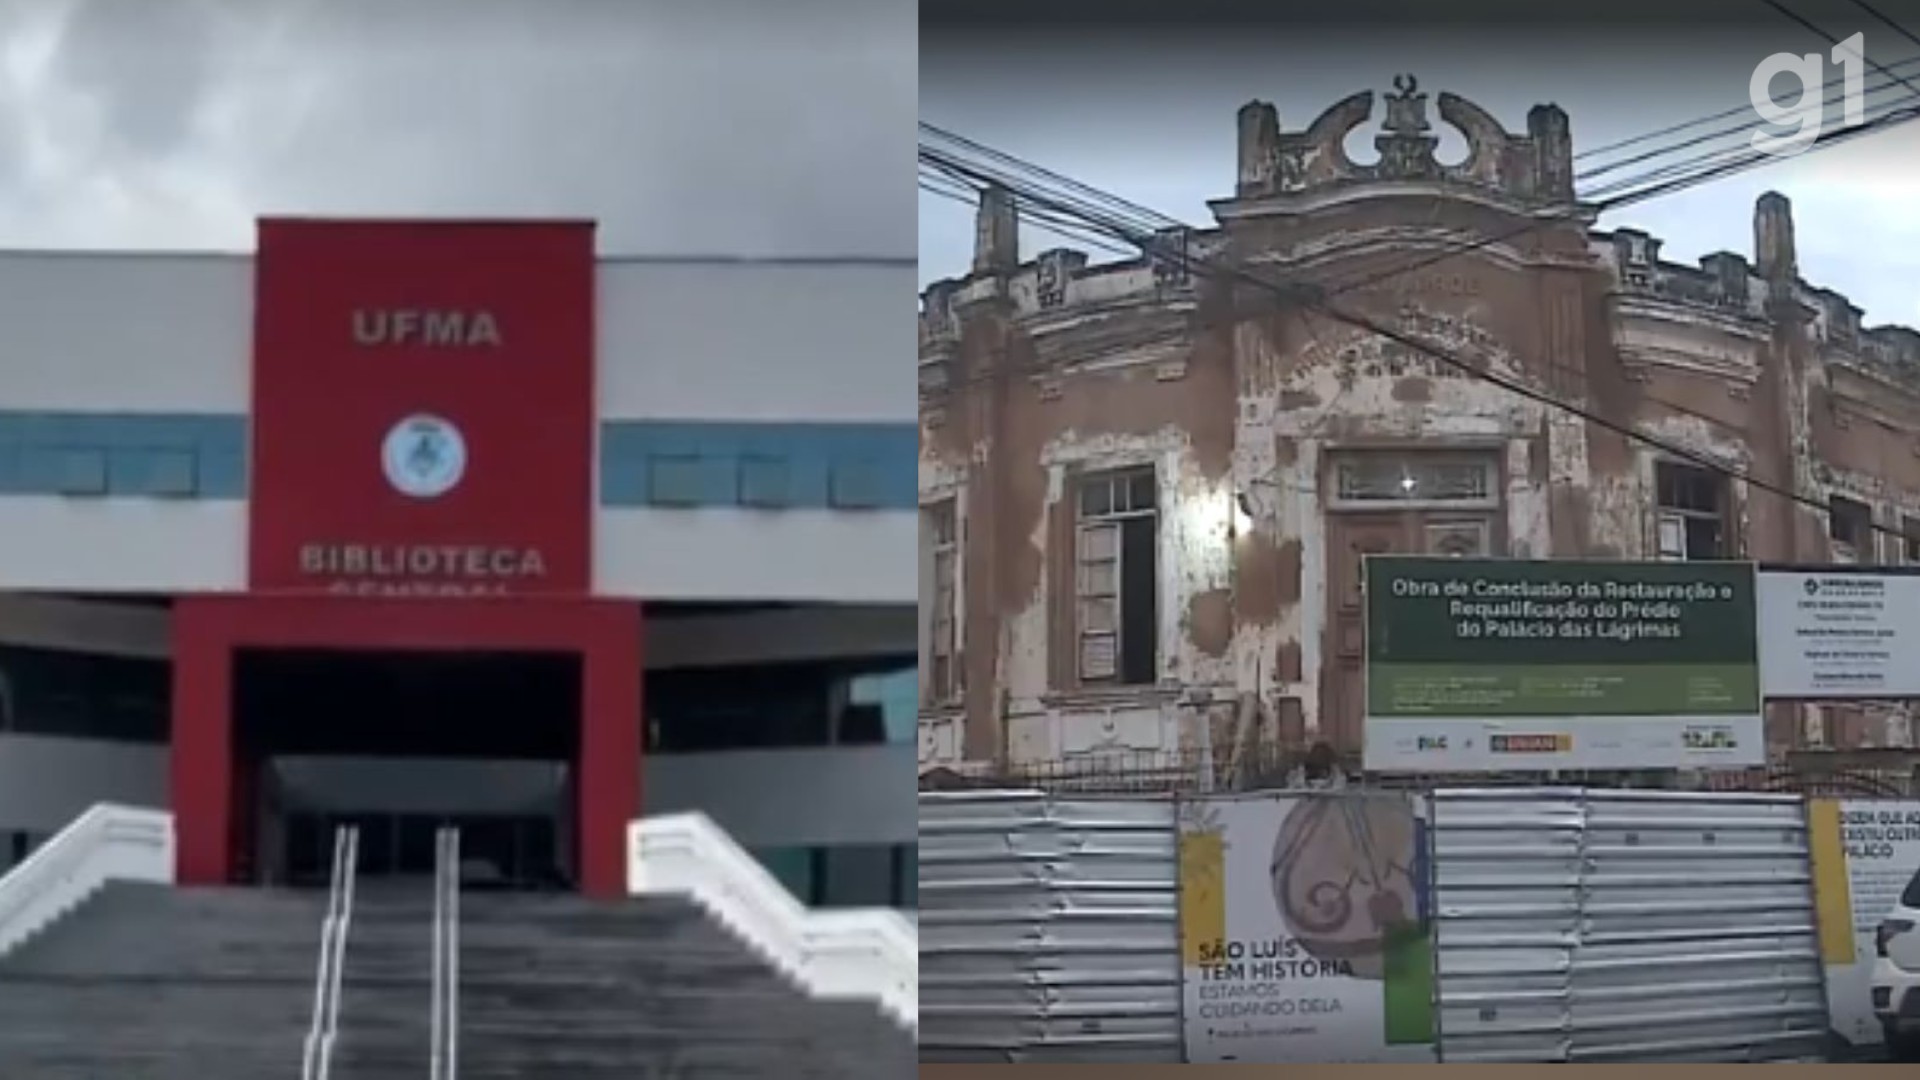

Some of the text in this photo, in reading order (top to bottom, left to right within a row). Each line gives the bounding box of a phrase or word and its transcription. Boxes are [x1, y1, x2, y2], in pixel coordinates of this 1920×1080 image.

[352, 309, 501, 345] UFMA
[301, 544, 545, 575] BIBLIOTECA
[1392, 578, 1732, 602] Obra de Conclusão da Restauração e
[1450, 600, 1681, 620] Requalificação do Prédio
[1457, 619, 1681, 641] do Palácio das Lágrimas
[1199, 935, 1298, 960] SÃO LUÍS
[1199, 956, 1352, 981] TEM HISTÓRIA
[1199, 983, 1280, 999] ESTAMOS
[1199, 998, 1343, 1019] CUIDANDO DELA
